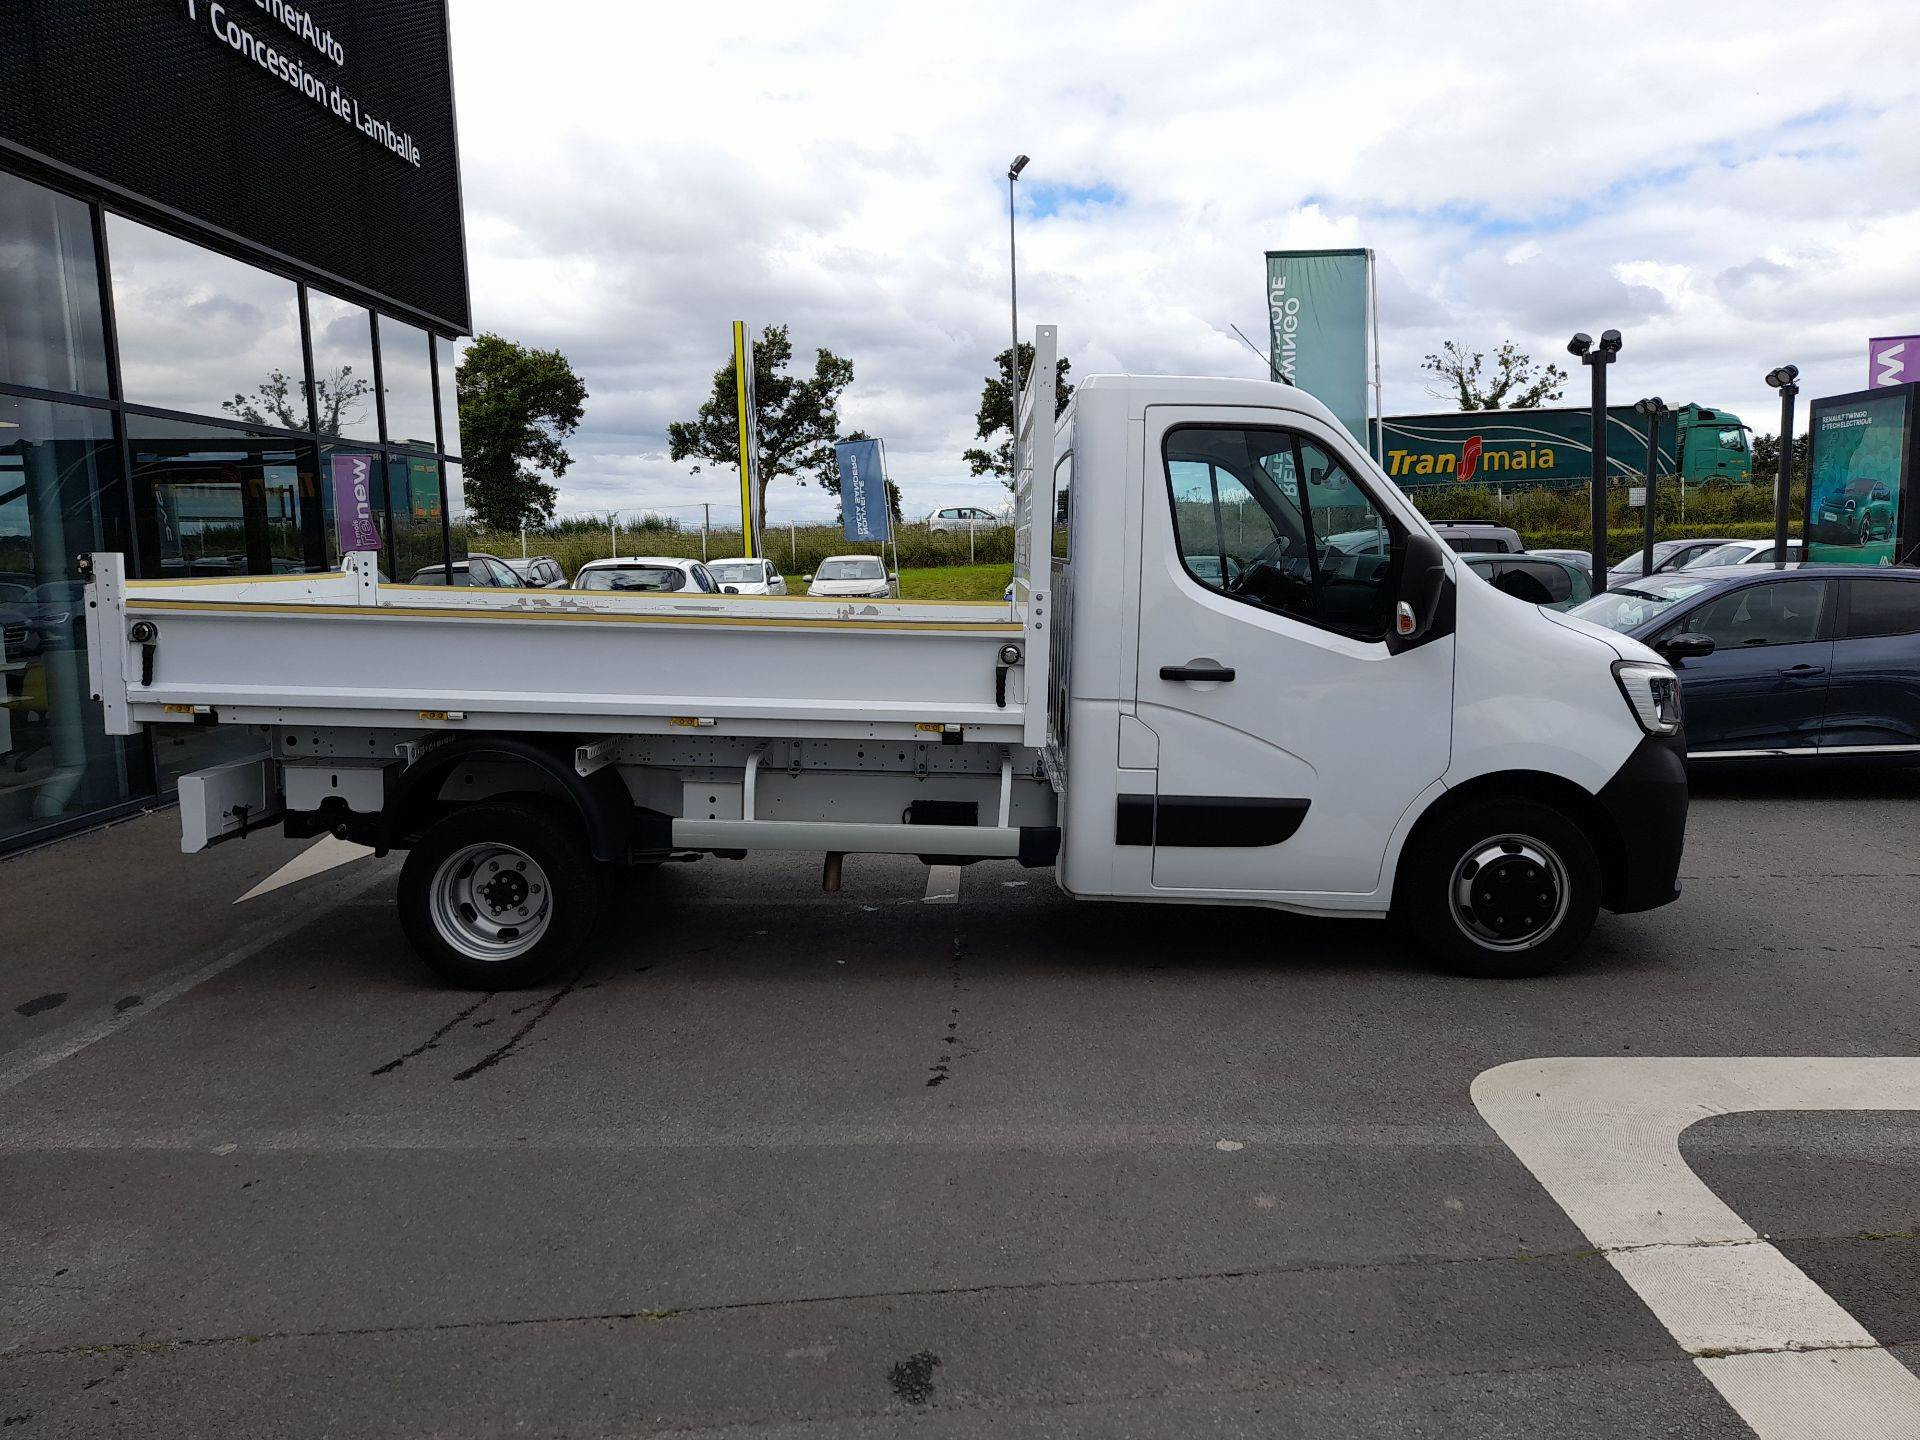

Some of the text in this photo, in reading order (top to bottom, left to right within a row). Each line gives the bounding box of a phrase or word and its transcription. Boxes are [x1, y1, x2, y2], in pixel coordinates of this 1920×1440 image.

[210, 2, 421, 168] Concession de Lamballe
[353, 458, 377, 546] renew
